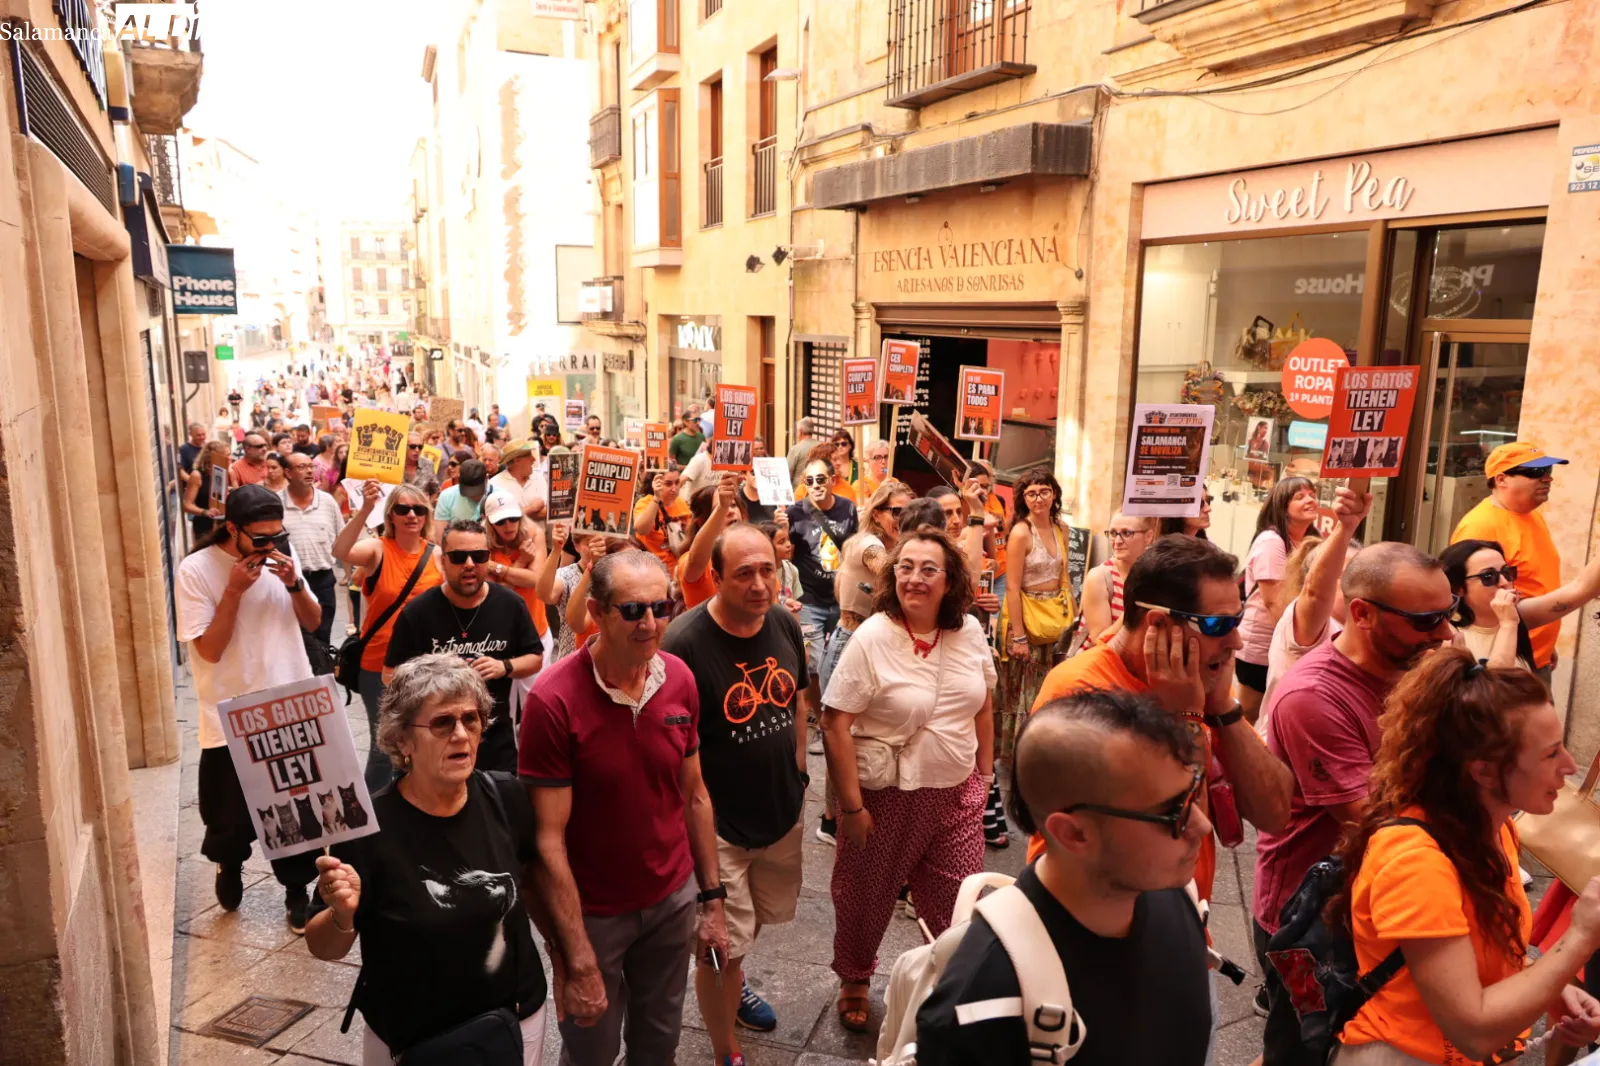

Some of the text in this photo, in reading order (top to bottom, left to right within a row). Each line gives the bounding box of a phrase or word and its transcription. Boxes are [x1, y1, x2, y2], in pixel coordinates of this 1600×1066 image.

[1224, 160, 1415, 224] Sweet Pea
[873, 235, 1061, 273] ESENCIA VALENCIANA
[172, 275, 235, 291] Phone
[896, 275, 954, 294] ARTESANOS
[966, 273, 1025, 293] SONRISAS
[174, 291, 235, 307] House
[968, 383, 996, 396] ES PARA
[1294, 375, 1334, 391] ROPA
[1343, 371, 1413, 390] LOS GATOS
[719, 388, 756, 405] LOS GATOS
[967, 395, 988, 407] TODOS
[1349, 389, 1398, 408] TIENEN
[723, 403, 749, 418] TIENEN
[726, 419, 743, 436] LEY
[1352, 410, 1385, 431] LEY
[1141, 435, 1187, 446] SALAMANCA
[587, 461, 631, 480] CUMPLID
[585, 477, 616, 494] LA LEY
[230, 690, 333, 736] LOS GATOS
[248, 719, 323, 760] TIENEN
[270, 752, 315, 790] LEY
